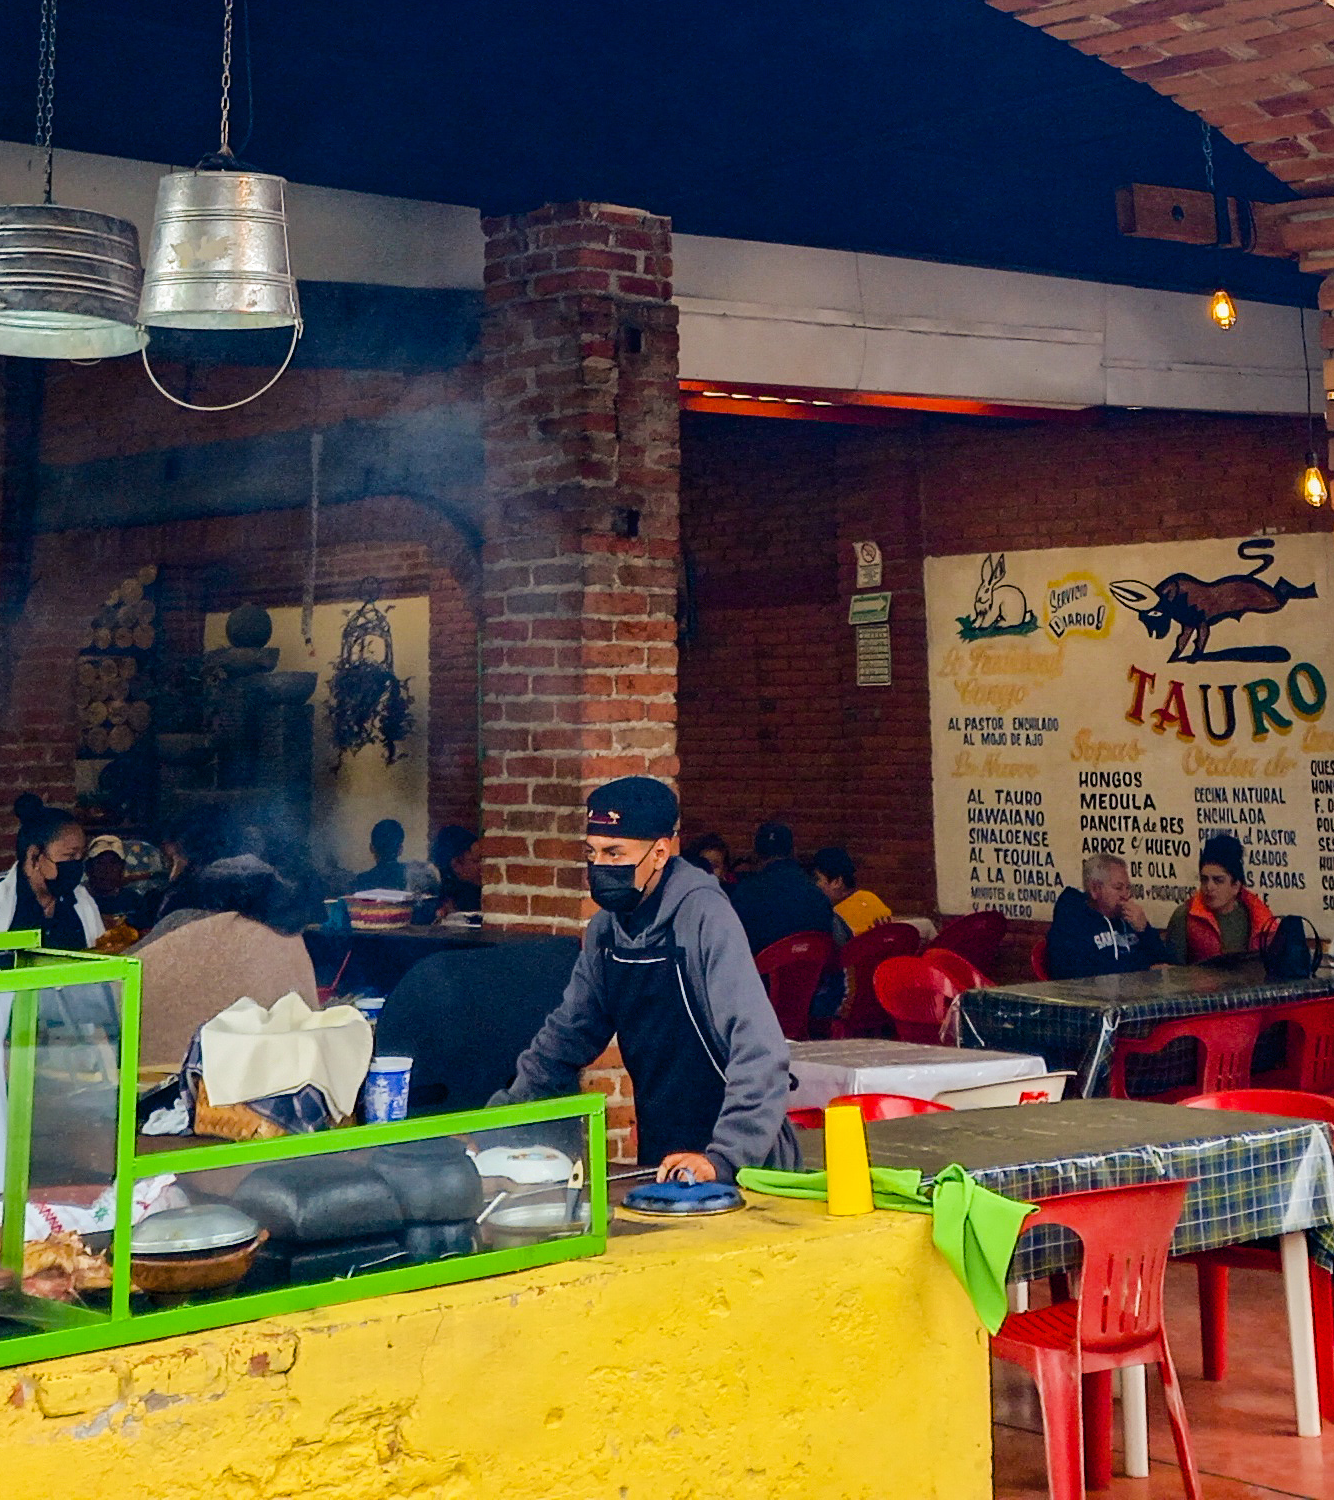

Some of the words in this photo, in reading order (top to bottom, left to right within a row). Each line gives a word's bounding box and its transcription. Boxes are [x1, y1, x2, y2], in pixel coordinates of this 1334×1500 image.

[1125, 662, 1327, 746] TAURO
[948, 717, 961, 731] AL
[964, 717, 1004, 731] PASTOR
[963, 733, 975, 746] AL
[981, 733, 1008, 746] MOJO
[1011, 733, 1021, 746] DE
[1025, 733, 1043, 747] AJO
[1079, 771, 1142, 788] HONGOS
[967, 788, 984, 804] AL
[995, 789, 1042, 806] TAURO
[1080, 793, 1156, 811] MEDULA
[1195, 787, 1228, 803] CECINA
[1233, 787, 1286, 804] NATURAL
[968, 808, 1044, 827] HAWAIANO
[1080, 815, 1141, 833] PANCITA
[1143, 816, 1157, 833] de
[1160, 816, 1184, 835] RES
[1197, 808, 1266, 825] ENCHILADA
[969, 827, 1049, 847] SINALOENSE
[1257, 829, 1296, 846] PASTOR
[1082, 837, 1126, 854] ARROZ
[1145, 838, 1191, 857] HUEVO
[969, 847, 984, 863] AL
[994, 847, 1055, 868] TEQUILA
[1249, 850, 1288, 867] ASADOS
[970, 866, 980, 882] A
[987, 867, 1005, 884] LA
[1013, 868, 1064, 889] DIABLA
[1131, 861, 1143, 878] DE
[1148, 862, 1177, 879] OLLA
[1260, 871, 1306, 890] ASADAS
[1017, 888, 1056, 903] CONEJO
